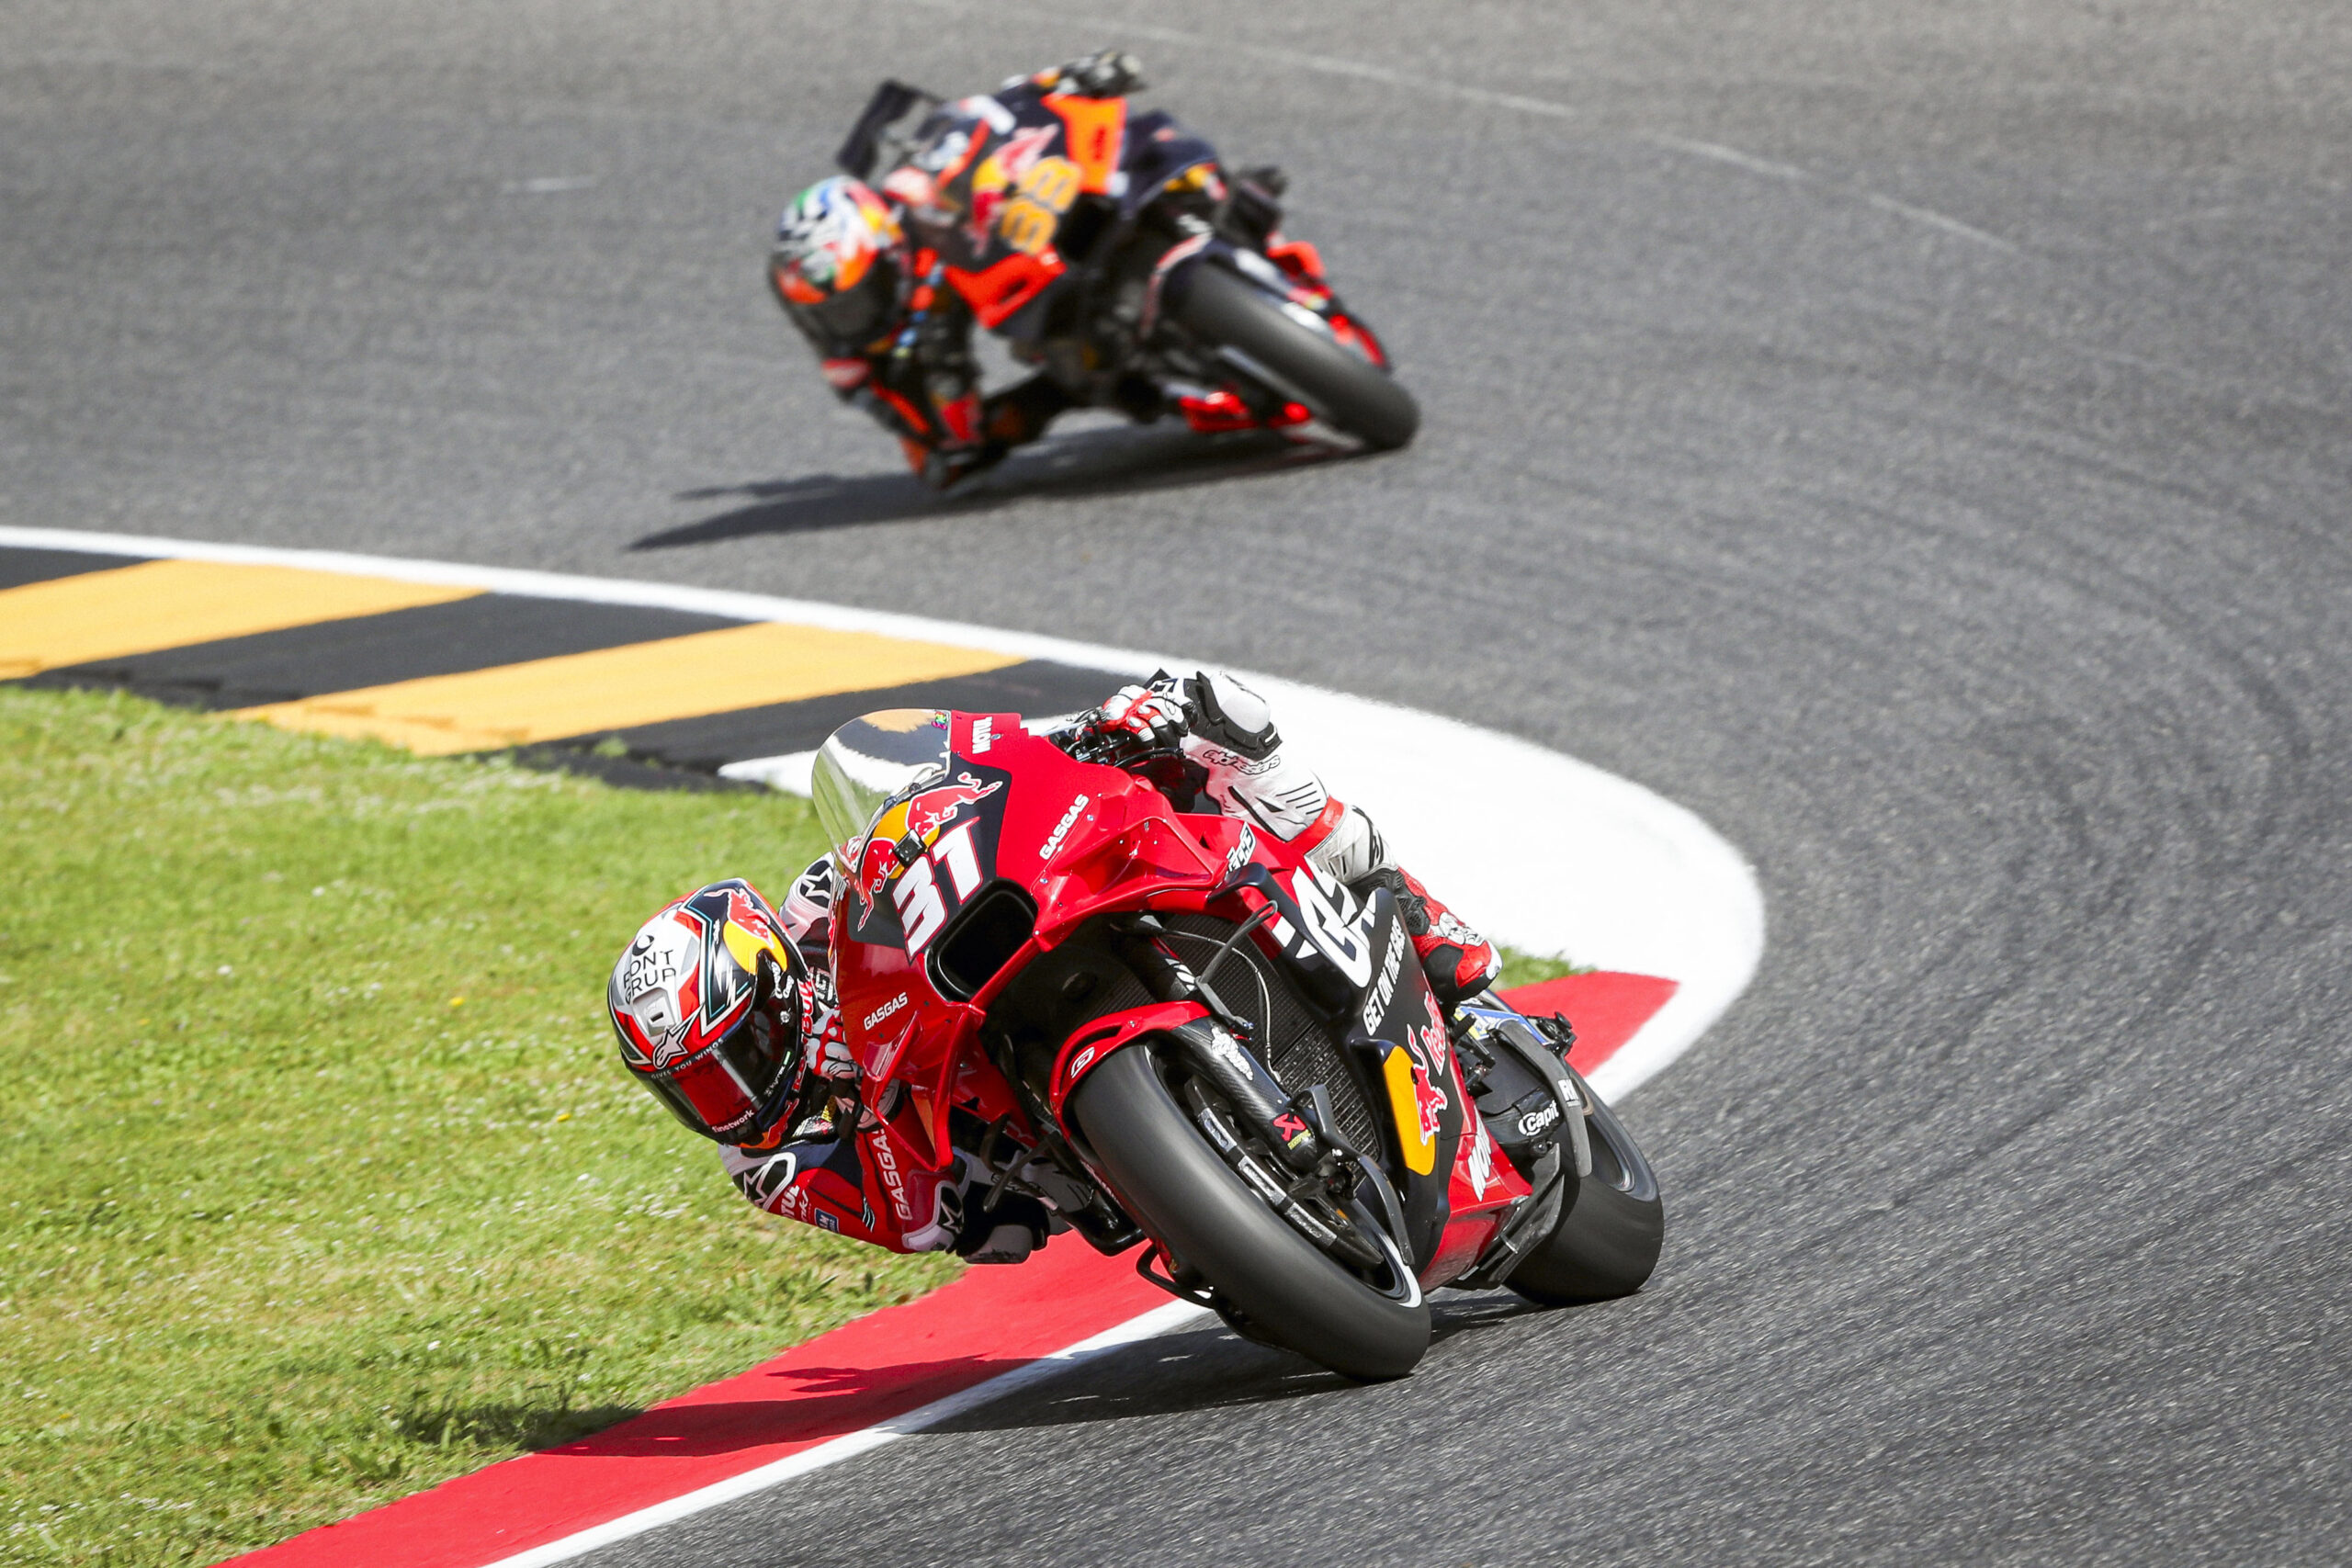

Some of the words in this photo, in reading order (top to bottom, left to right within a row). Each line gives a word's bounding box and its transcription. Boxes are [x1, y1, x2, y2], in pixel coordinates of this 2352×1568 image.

[1038, 794, 1090, 860] GASGAS
[892, 817, 983, 961] 31
[864, 991, 909, 1031] GASGAS
[1363, 987, 1385, 1036] GET
[1377, 966, 1395, 1007] ON
[674, 1060, 693, 1073] YOU
[695, 1038, 725, 1062] WINGS
[711, 1109, 754, 1133] finetwork
[781, 1184, 800, 1219] TUL
